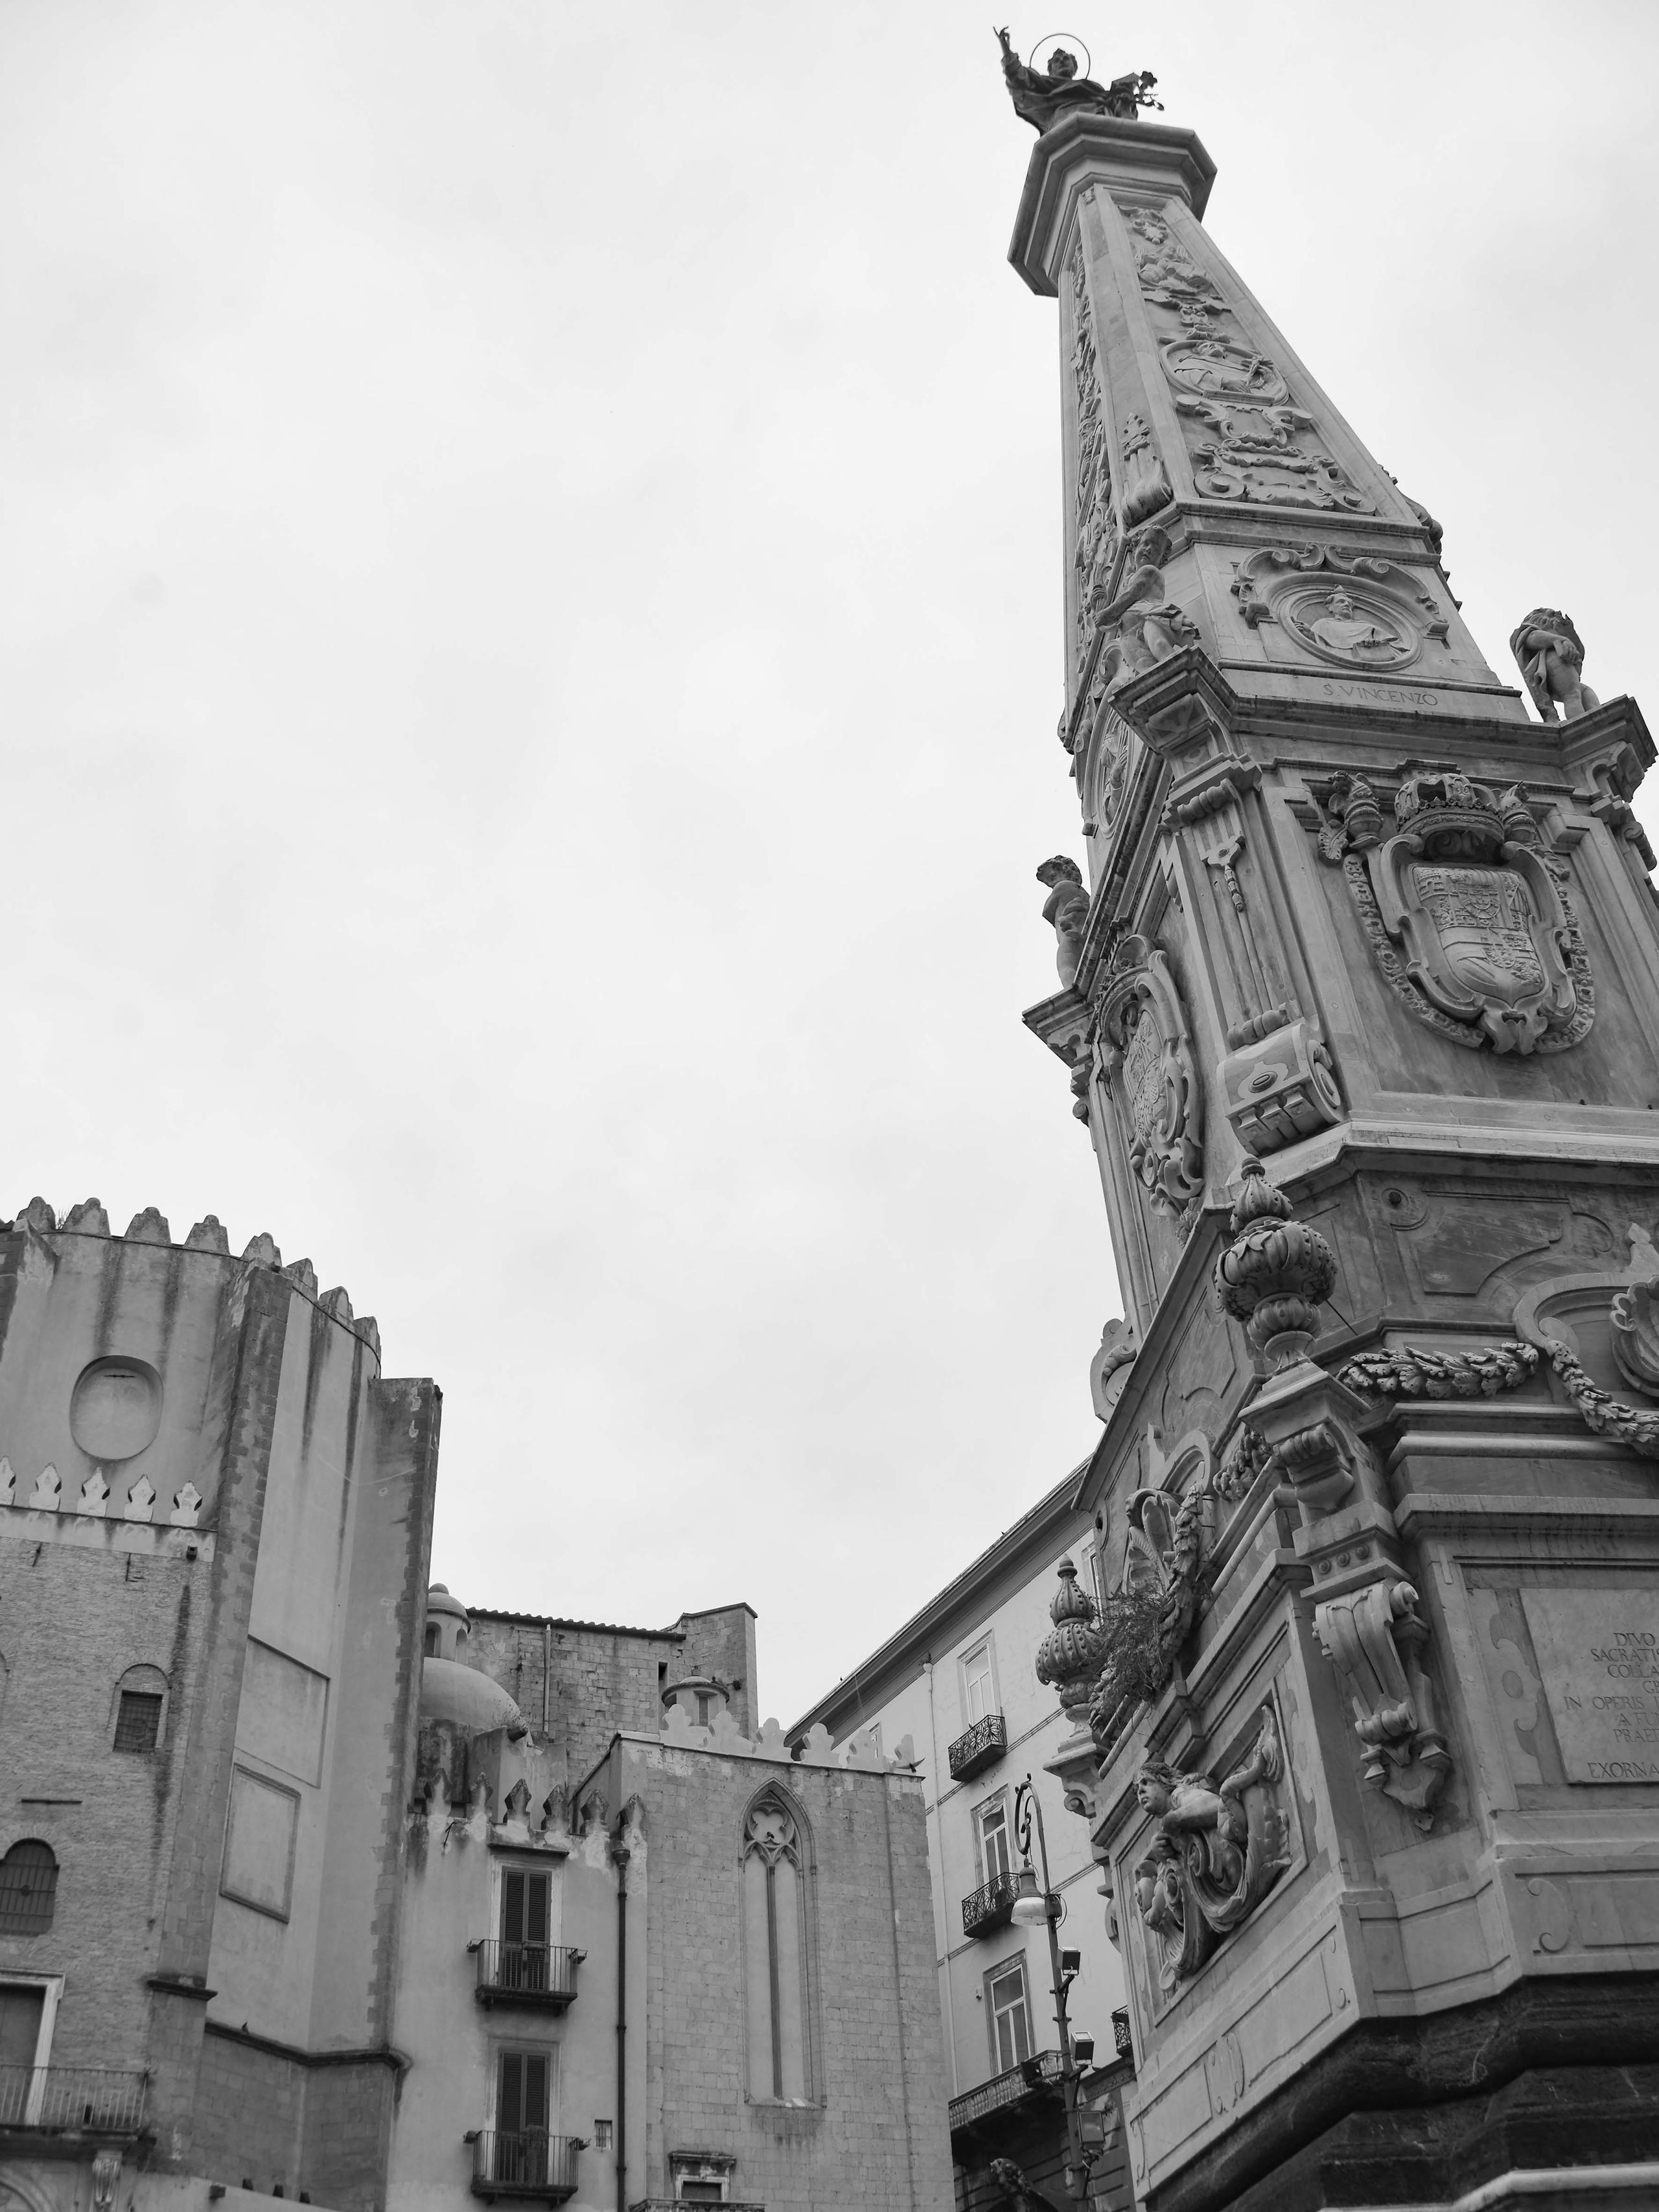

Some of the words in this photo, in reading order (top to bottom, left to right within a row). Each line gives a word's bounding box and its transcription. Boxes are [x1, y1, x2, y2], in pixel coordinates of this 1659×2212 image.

[1338, 685, 1438, 706] VINCENZO
[1612, 1632, 1656, 1646] DIVO
[1563, 1696, 1582, 1711] IN
[1592, 1696, 1645, 1711] OPERIS
[1618, 1712, 1632, 1726] A
